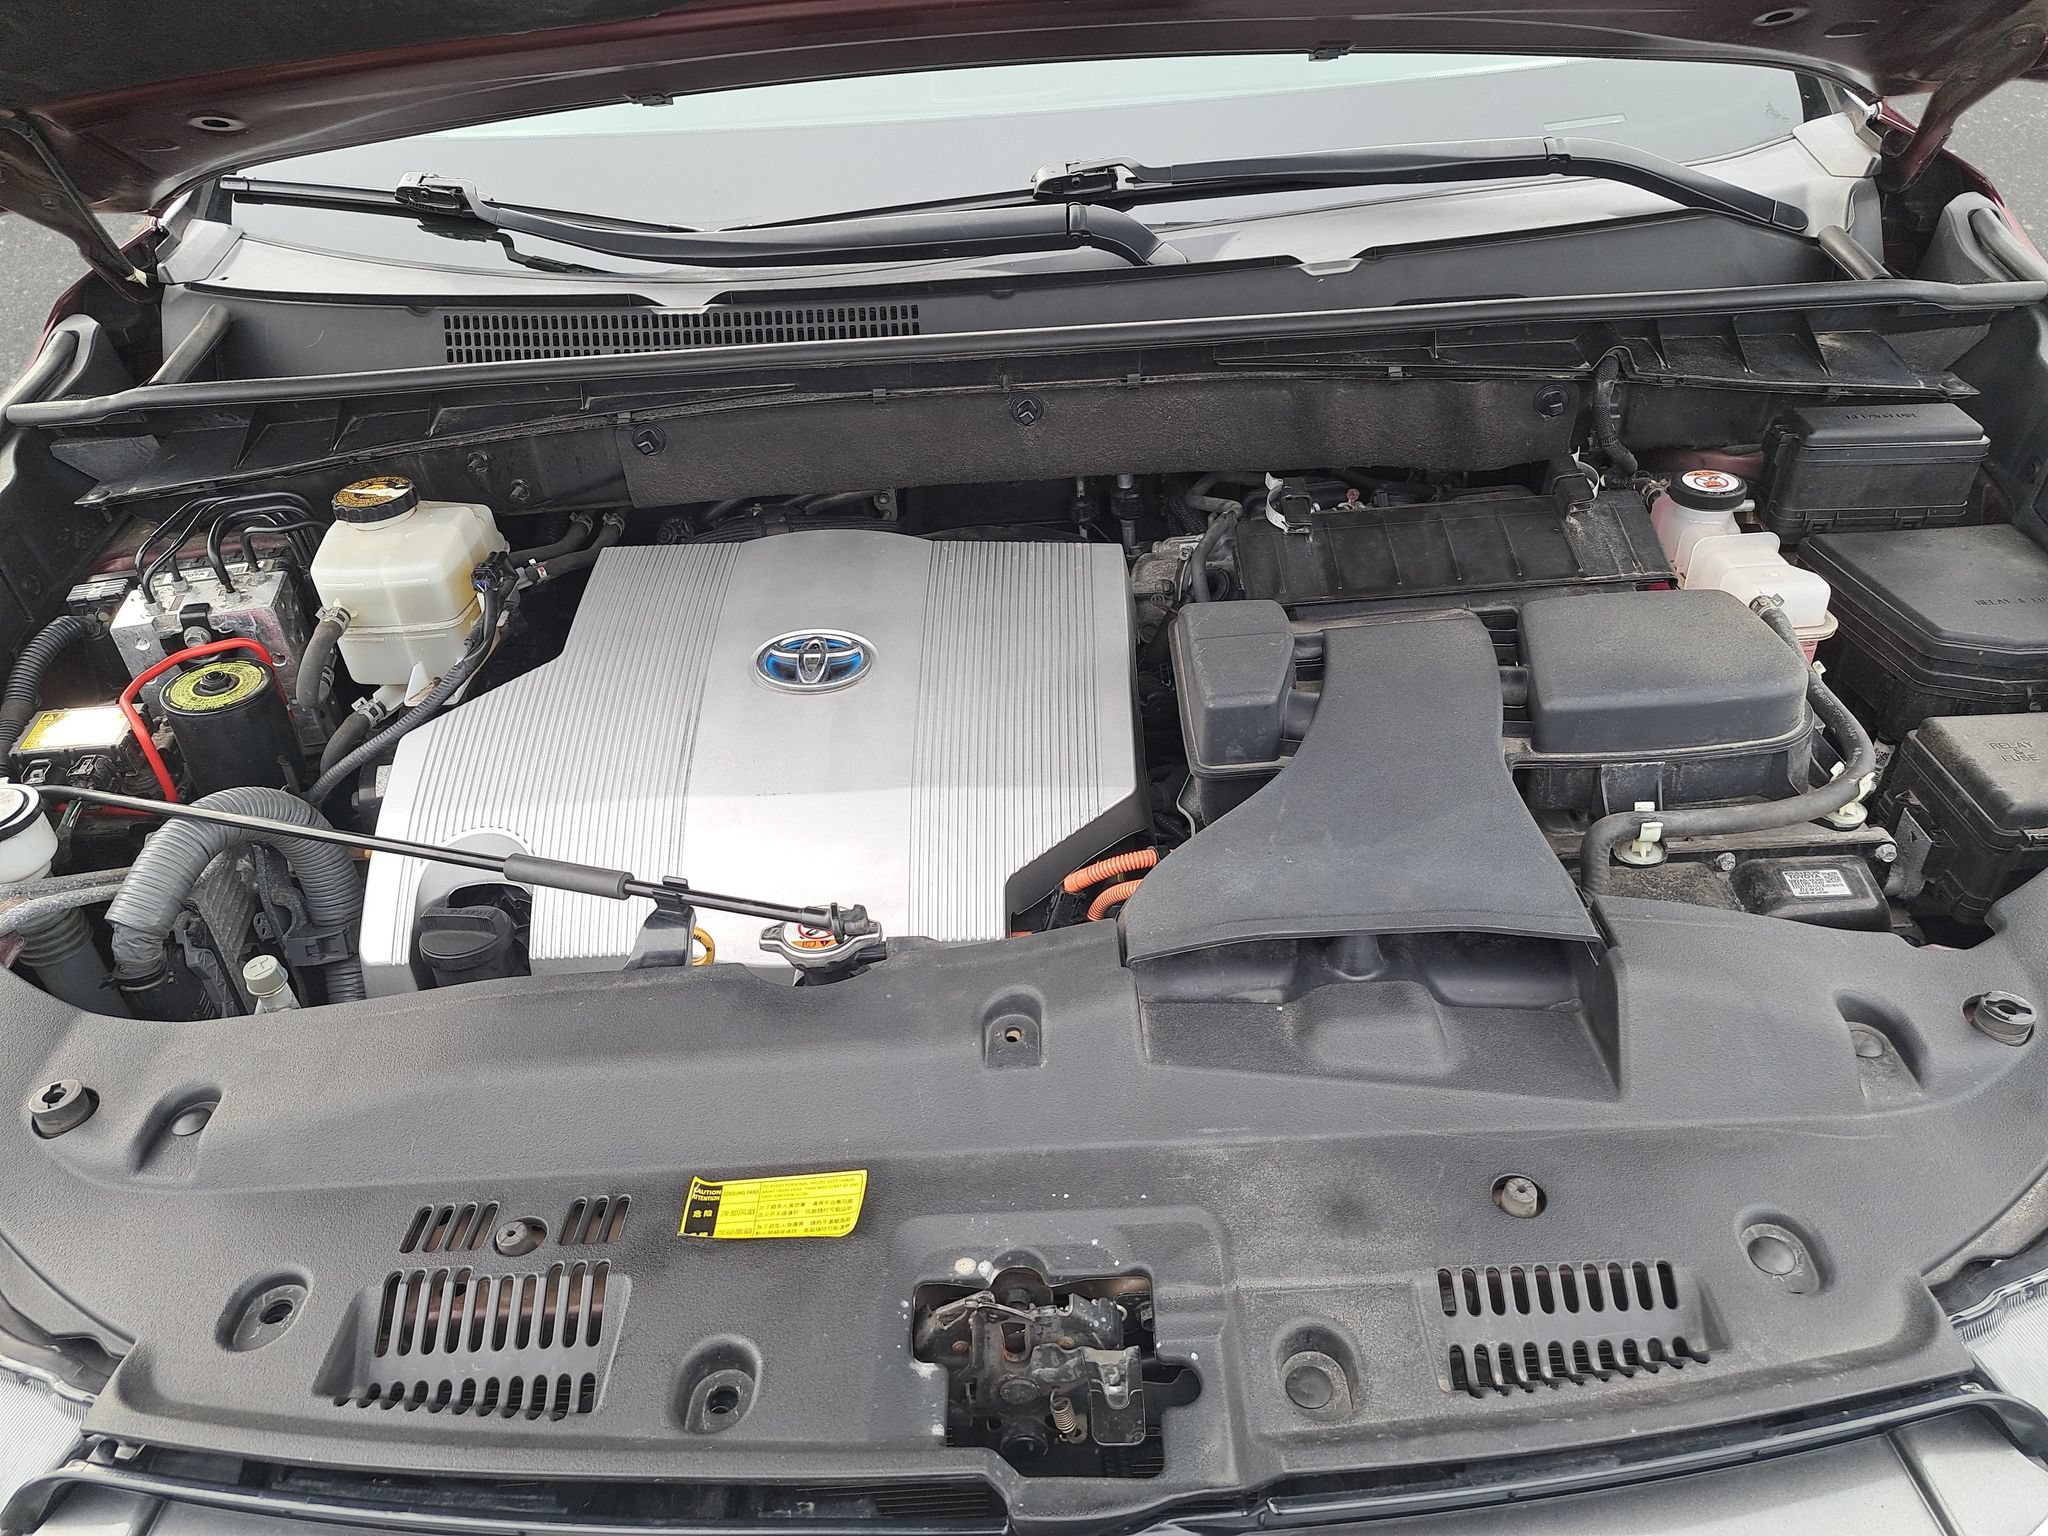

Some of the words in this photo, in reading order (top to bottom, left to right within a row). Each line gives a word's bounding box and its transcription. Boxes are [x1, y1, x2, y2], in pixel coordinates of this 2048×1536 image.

[1988, 741, 2033, 750] RELAY
[2000, 753, 2041, 762] FUSE
[694, 1184, 722, 1196] CAUTION
